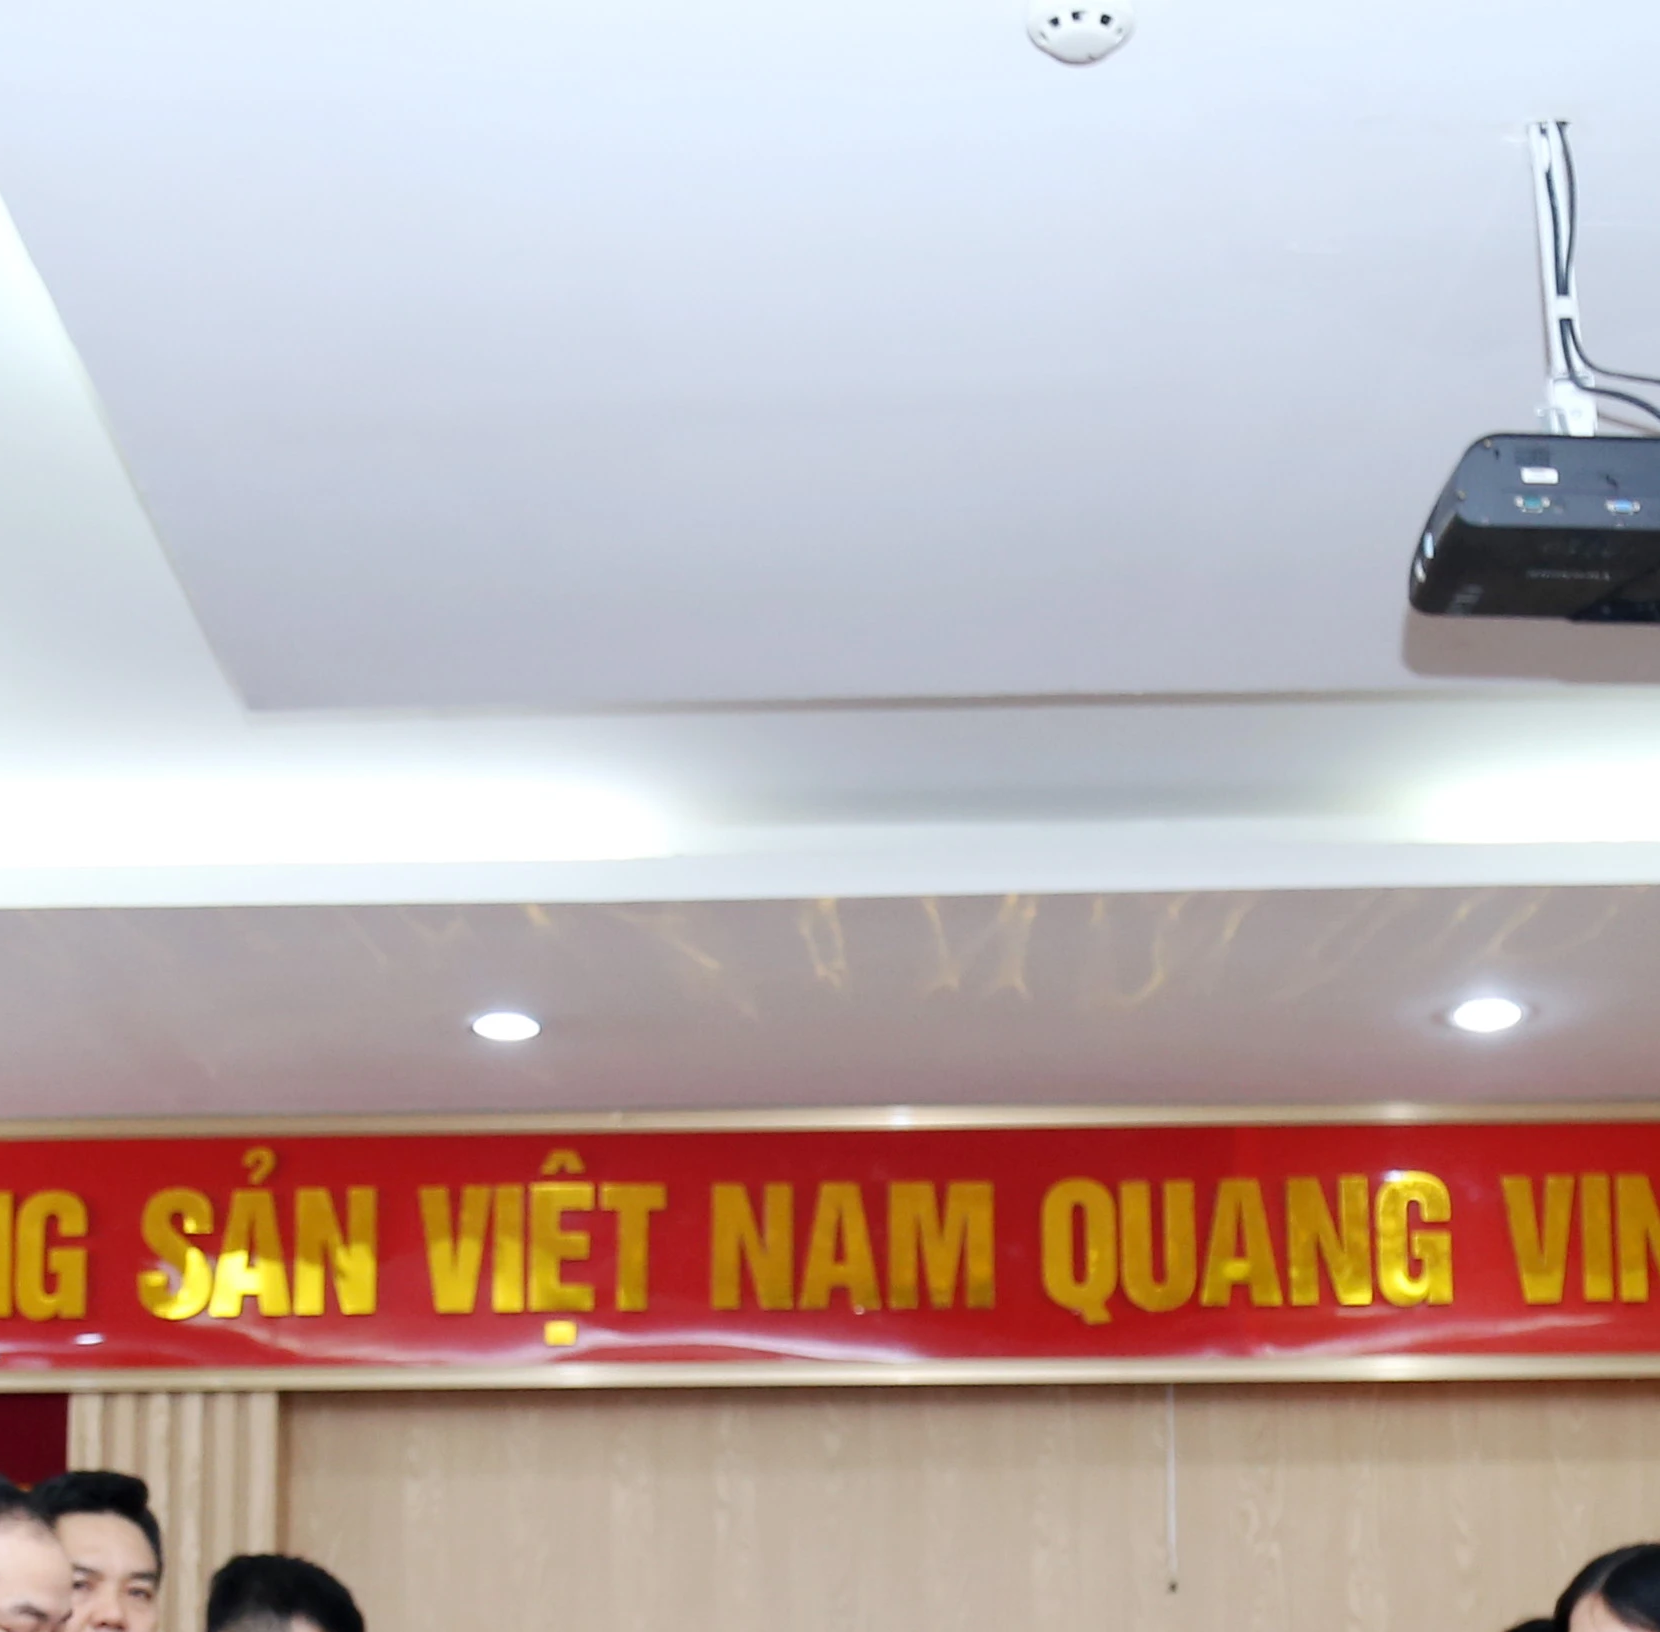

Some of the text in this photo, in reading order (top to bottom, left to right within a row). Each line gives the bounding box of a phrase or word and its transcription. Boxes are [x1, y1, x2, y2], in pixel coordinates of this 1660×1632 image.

[137, 1146, 379, 1321] SẢN
[417, 1150, 666, 1347] VIỆT
[710, 1182, 995, 1310] NAM
[1040, 1170, 1454, 1325] QUANG
